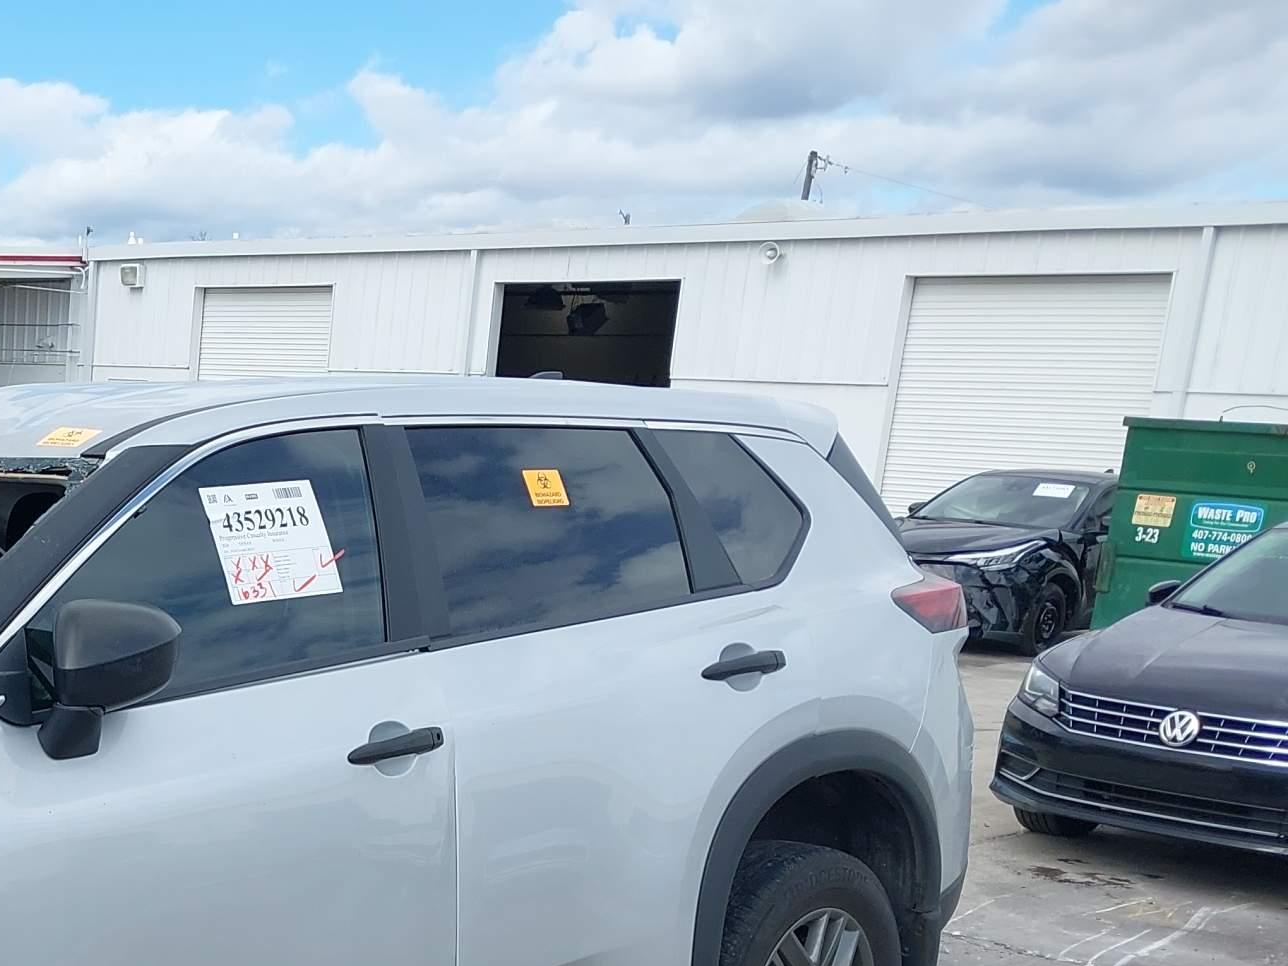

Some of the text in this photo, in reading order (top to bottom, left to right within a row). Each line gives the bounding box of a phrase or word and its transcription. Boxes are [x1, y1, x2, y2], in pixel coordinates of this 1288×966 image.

[223, 506, 309, 532] 43529218
[1197, 506, 1234, 521] WASTE
[1236, 510, 1258, 524] PRO
[1135, 527, 1159, 543] 3-23
[1191, 542, 1236, 554] NO PARK
